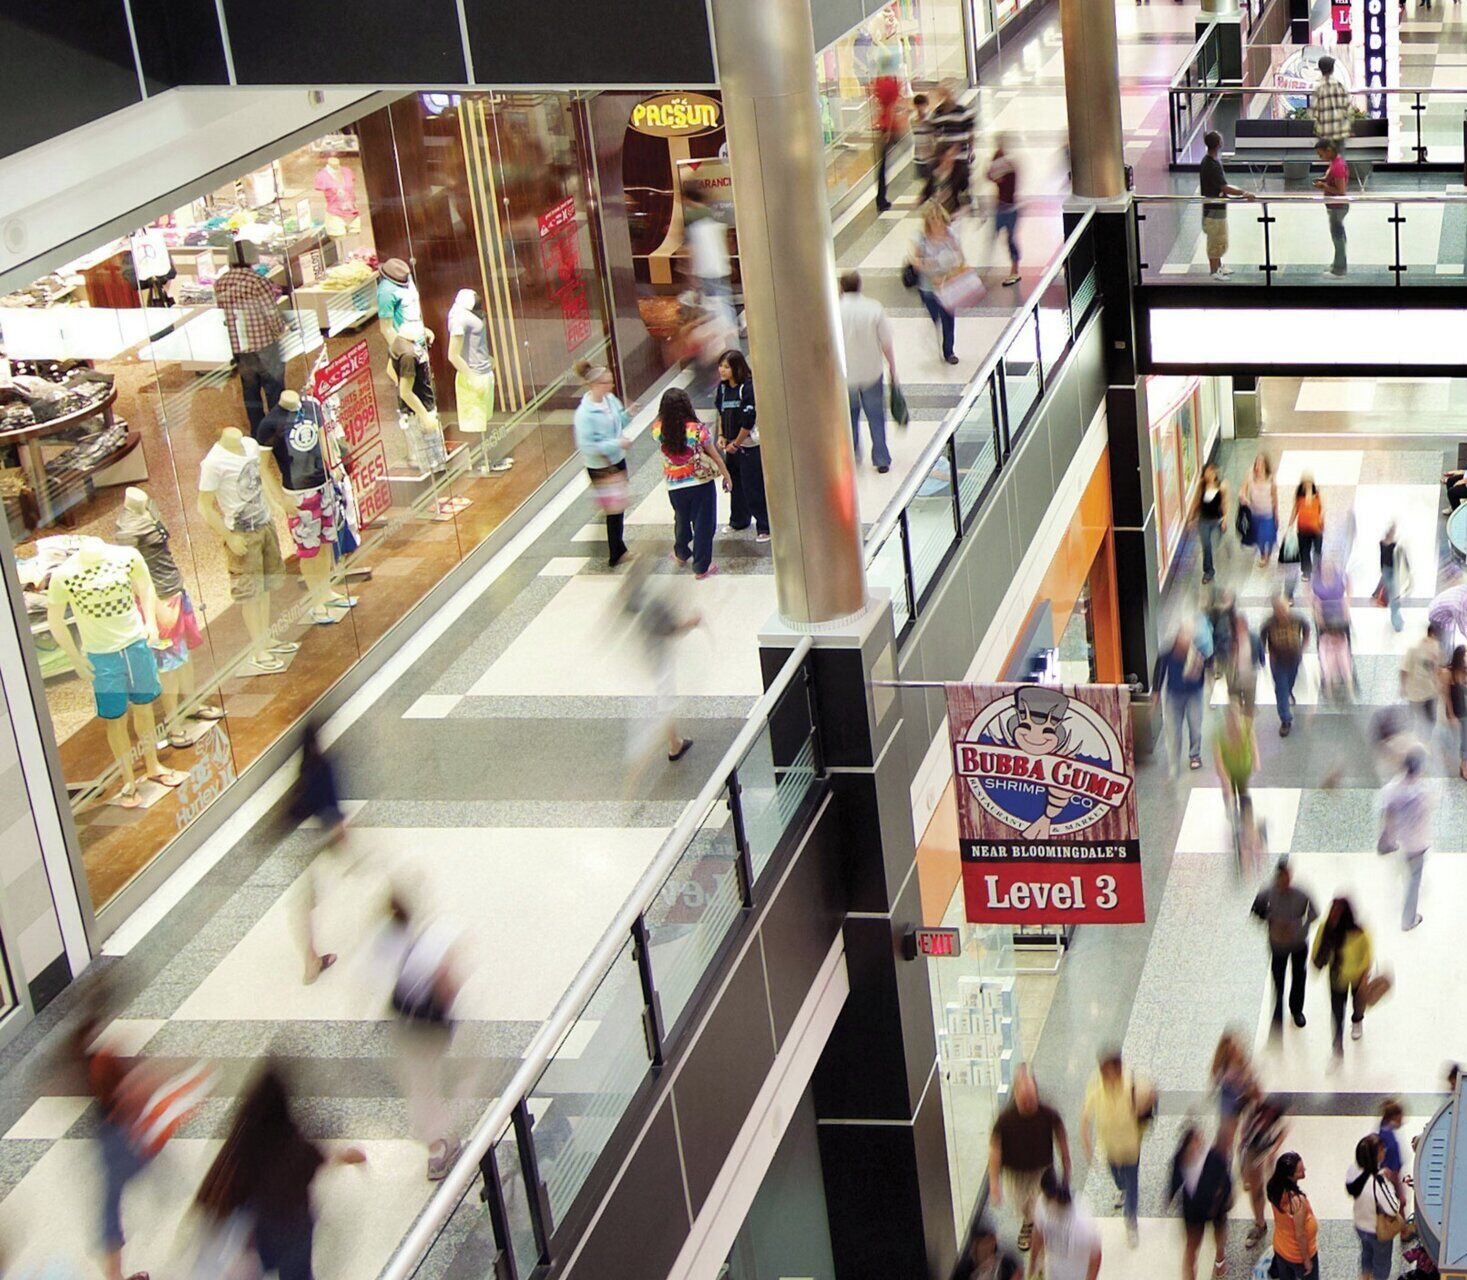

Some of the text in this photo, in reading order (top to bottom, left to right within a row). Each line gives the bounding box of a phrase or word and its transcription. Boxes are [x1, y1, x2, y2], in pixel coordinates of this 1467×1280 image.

[353, 454, 385, 493] TEES
[358, 483, 390, 519] FREE
[961, 747, 1125, 800] BUBBA GUMP
[984, 778, 1046, 795] SHRIMP
[969, 778, 1024, 828] RESTAURANT
[1065, 806, 1105, 831] MARKET
[972, 845, 1127, 859] NEAR BLOOMINGDALE'S
[984, 875, 1118, 910] Level 3
[920, 933, 953, 955] EXIT
